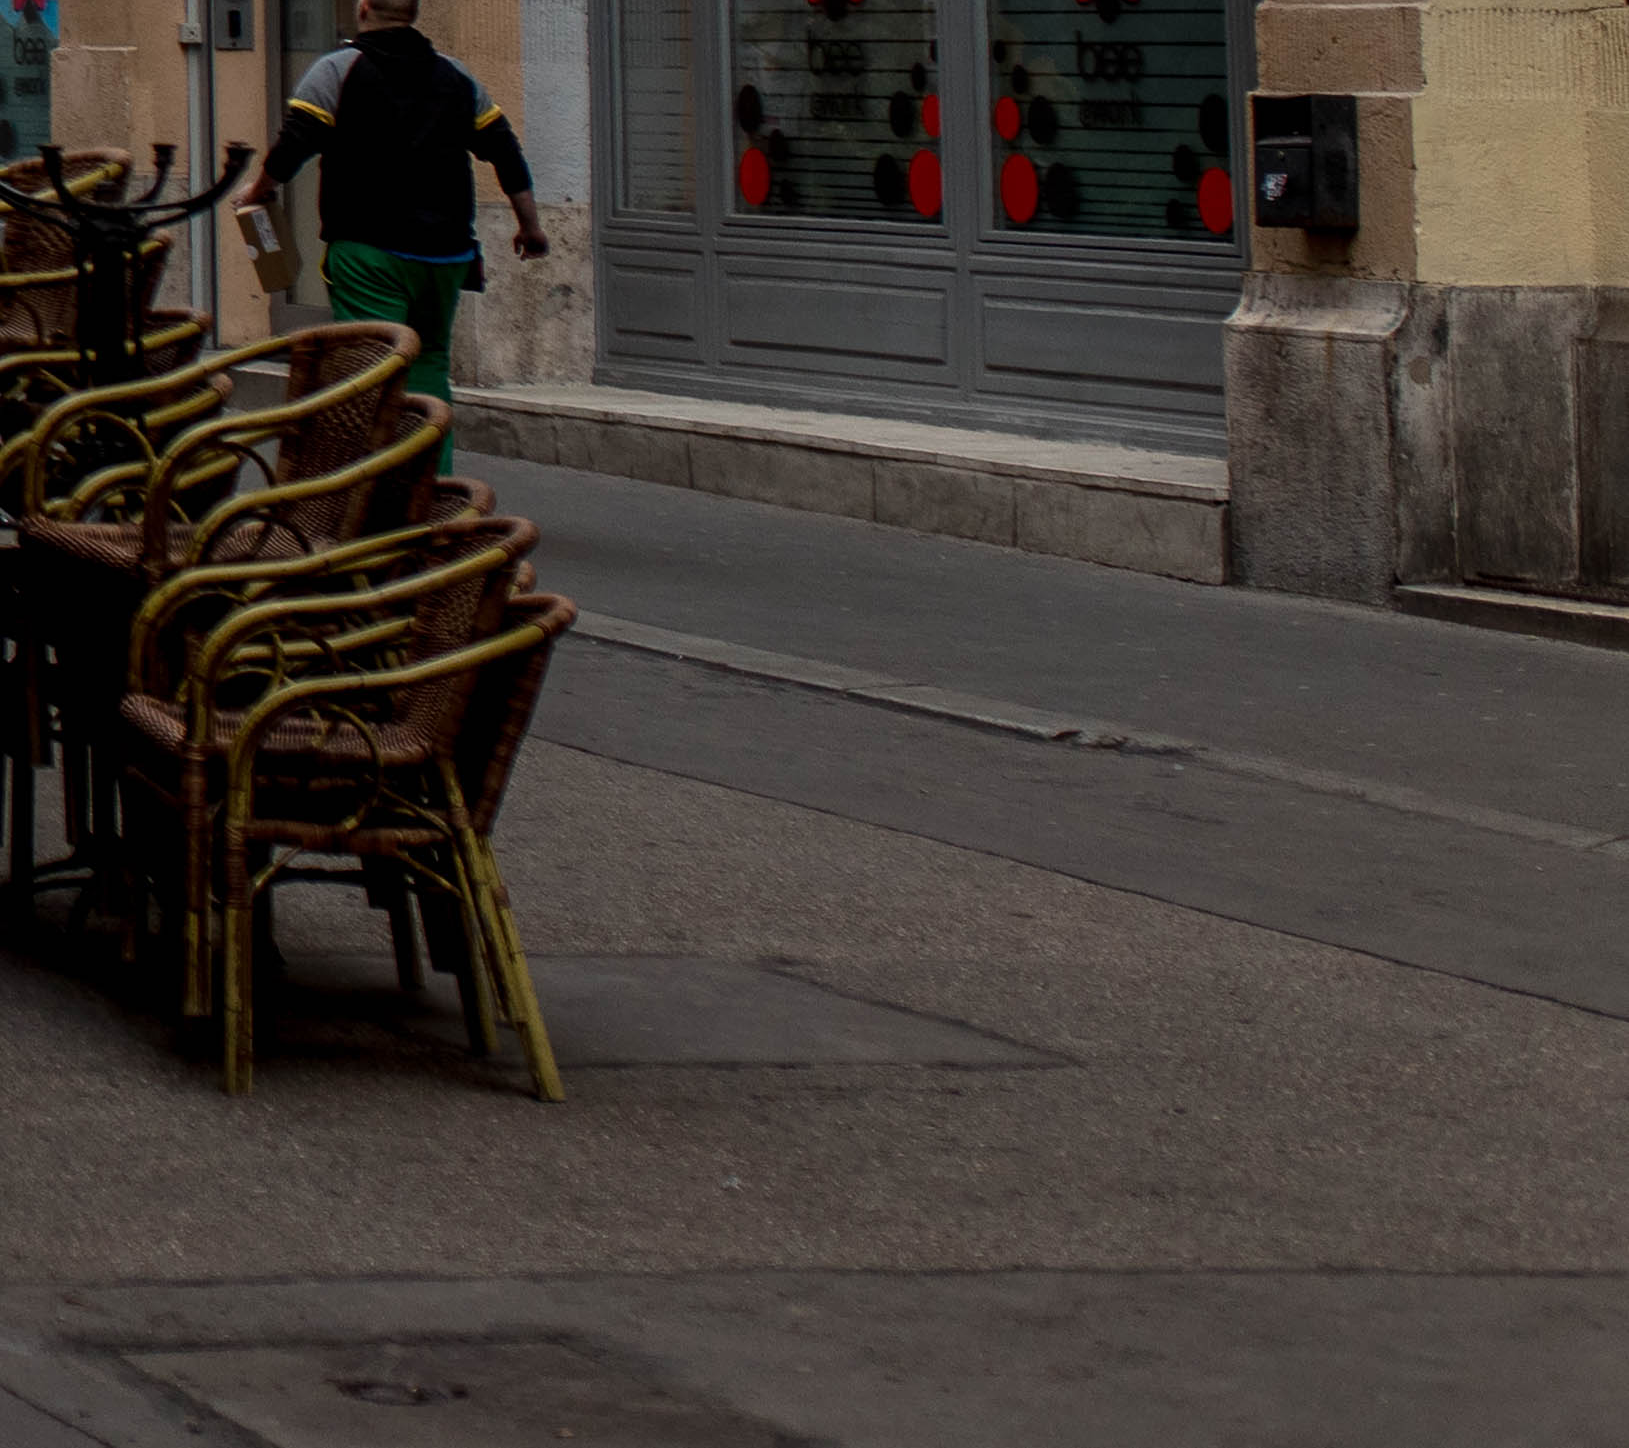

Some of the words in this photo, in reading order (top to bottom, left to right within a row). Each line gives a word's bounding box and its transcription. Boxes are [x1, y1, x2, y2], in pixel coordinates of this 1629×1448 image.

[14, 29, 47, 66] bee
[808, 28, 864, 76] bee
[1076, 30, 1143, 82] bee
